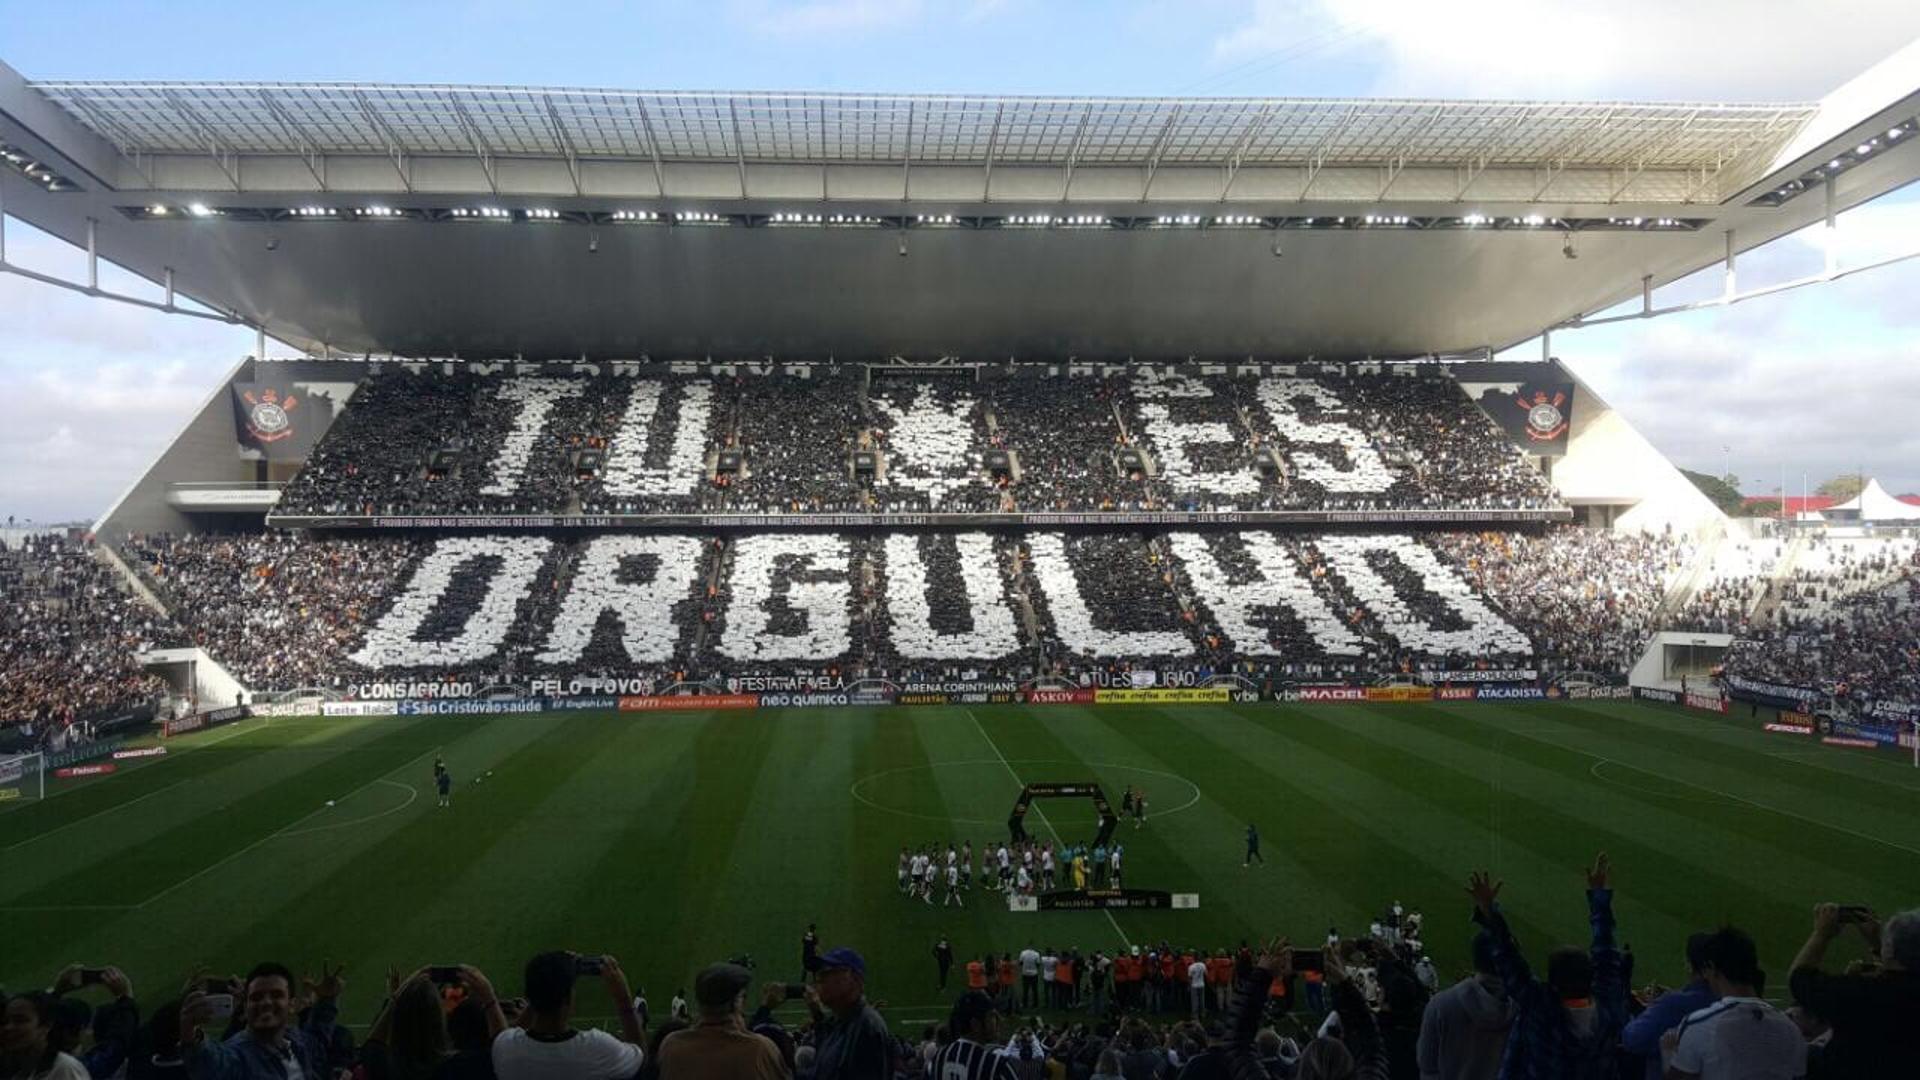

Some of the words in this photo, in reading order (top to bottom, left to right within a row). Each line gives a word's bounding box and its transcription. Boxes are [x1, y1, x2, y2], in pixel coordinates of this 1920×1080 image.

[480, 377, 713, 496] TU
[345, 532, 1533, 668] ORGULHO
[360, 683, 472, 698] CONSAGRADO
[531, 679, 581, 696] PELO
[591, 678, 642, 694] POVO
[904, 683, 942, 692] ARENA
[943, 682, 1017, 692] CORINTHIANS
[1477, 689, 1544, 698] ATACADISTA
[761, 694, 789, 706] neo
[1032, 692, 1074, 701] ASKOV
[1301, 689, 1366, 699] MADEL
[412, 701, 437, 714] São
[439, 700, 499, 714] Cristóvão
[501, 700, 541, 714] saúde
